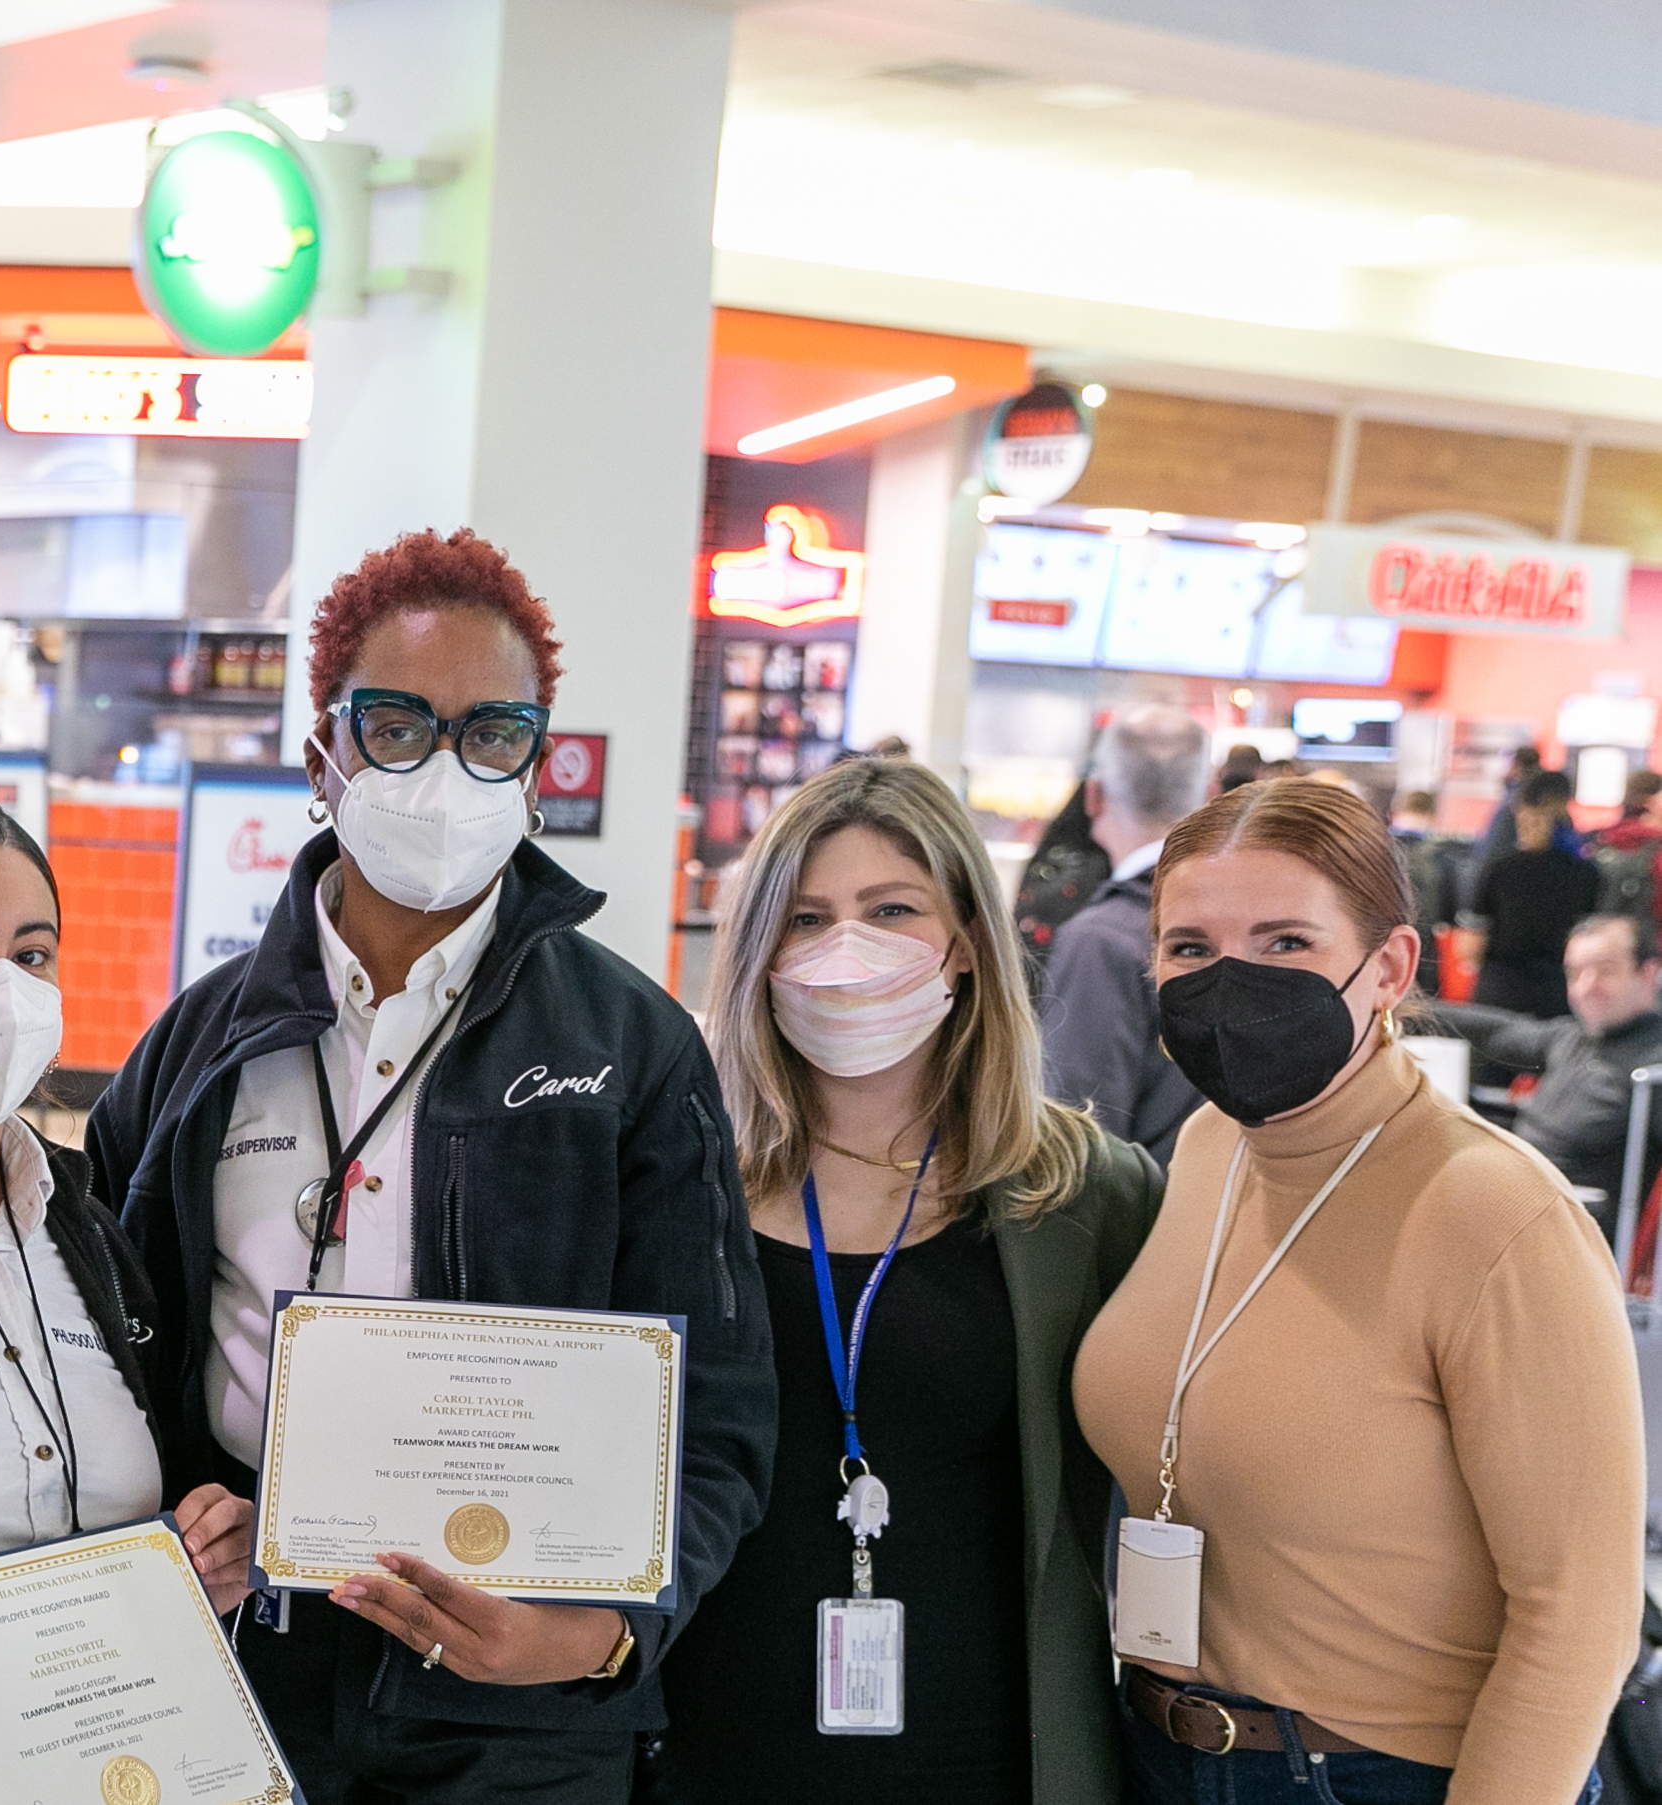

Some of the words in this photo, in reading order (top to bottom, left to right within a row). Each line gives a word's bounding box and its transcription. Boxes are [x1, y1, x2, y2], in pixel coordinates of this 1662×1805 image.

[503, 1065, 613, 1107] Carol
[235, 1136, 297, 1156] SUPERVISOR
[850, 1287, 873, 1345] INTERNATIONAL
[363, 1327, 448, 1341] PHILADELPHIA
[452, 1332, 550, 1347] INTERNATIONAL
[553, 1340, 605, 1351] AIRPORT
[406, 1351, 454, 1362] EMPLOYEE
[456, 1354, 521, 1366] RECOGNITION
[523, 1358, 558, 1369] AWARD
[450, 1374, 498, 1385] PRESENTED
[500, 1377, 512, 1385] TO
[433, 1394, 474, 1405] CAROL
[477, 1396, 525, 1407] TAYLOR
[421, 1405, 509, 1418] MARKETPLACE
[512, 1409, 535, 1420] PHL
[437, 1428, 470, 1437] AWARD
[471, 1430, 516, 1439] CATEGORY
[393, 1438, 445, 1447] TEAMWORK
[447, 1440, 477, 1449] MAKES
[480, 1441, 496, 1449] THE
[498, 1442, 530, 1451] DREAM
[532, 1444, 560, 1452] WORK
[444, 1461, 492, 1470] PRESENTED
[494, 1463, 505, 1471] BY
[375, 1469, 391, 1478] THE
[393, 1470, 420, 1479] GUEST
[422, 1472, 472, 1481] EXPERIENCE
[474, 1473, 534, 1483] STAKEHOLDER
[536, 1476, 575, 1485] COUNCIL
[436, 1488, 475, 1496] December
[477, 1489, 488, 1498] 16,
[490, 1489, 509, 1497] 2021
[306, 1548, 337, 1556] Philadelphia
[15, 1569, 94, 1597] INTERNATIONAL
[94, 1560, 134, 1579] AIRPORT
[30, 1597, 82, 1617] RECOGNITION
[83, 1590, 110, 1604] AWARD
[35, 1623, 75, 1639] PRESENTED
[75, 1620, 86, 1630] TO
[34, 1646, 76, 1665] CELINES
[76, 1638, 107, 1656] ORTIZ
[29, 1654, 102, 1680] MARKETPLACE
[102, 1649, 122, 1662] PHL
[54, 1685, 81, 1698] AWARD
[81, 1674, 118, 1691] CATEGORY
[20, 1700, 67, 1721] TEAMWORK
[67, 1694, 93, 1707] MAKES
[93, 1689, 107, 1699] THE
[107, 1683, 134, 1696] DREAM
[135, 1677, 157, 1689] WORK
[74, 1713, 115, 1729] PRESENTED
[115, 1708, 126, 1718] BY
[19, 1748, 35, 1760] THE
[36, 1740, 61, 1754] GUEST
[61, 1727, 105, 1747] EXPERIENCE
[105, 1713, 153, 1734] STAKEHOLDER
[153, 1706, 183, 1720] COUNCIL
[79, 1742, 116, 1759] DECEMBER
[116, 1739, 128, 1748] 16,
[127, 1734, 144, 1744] 2021
